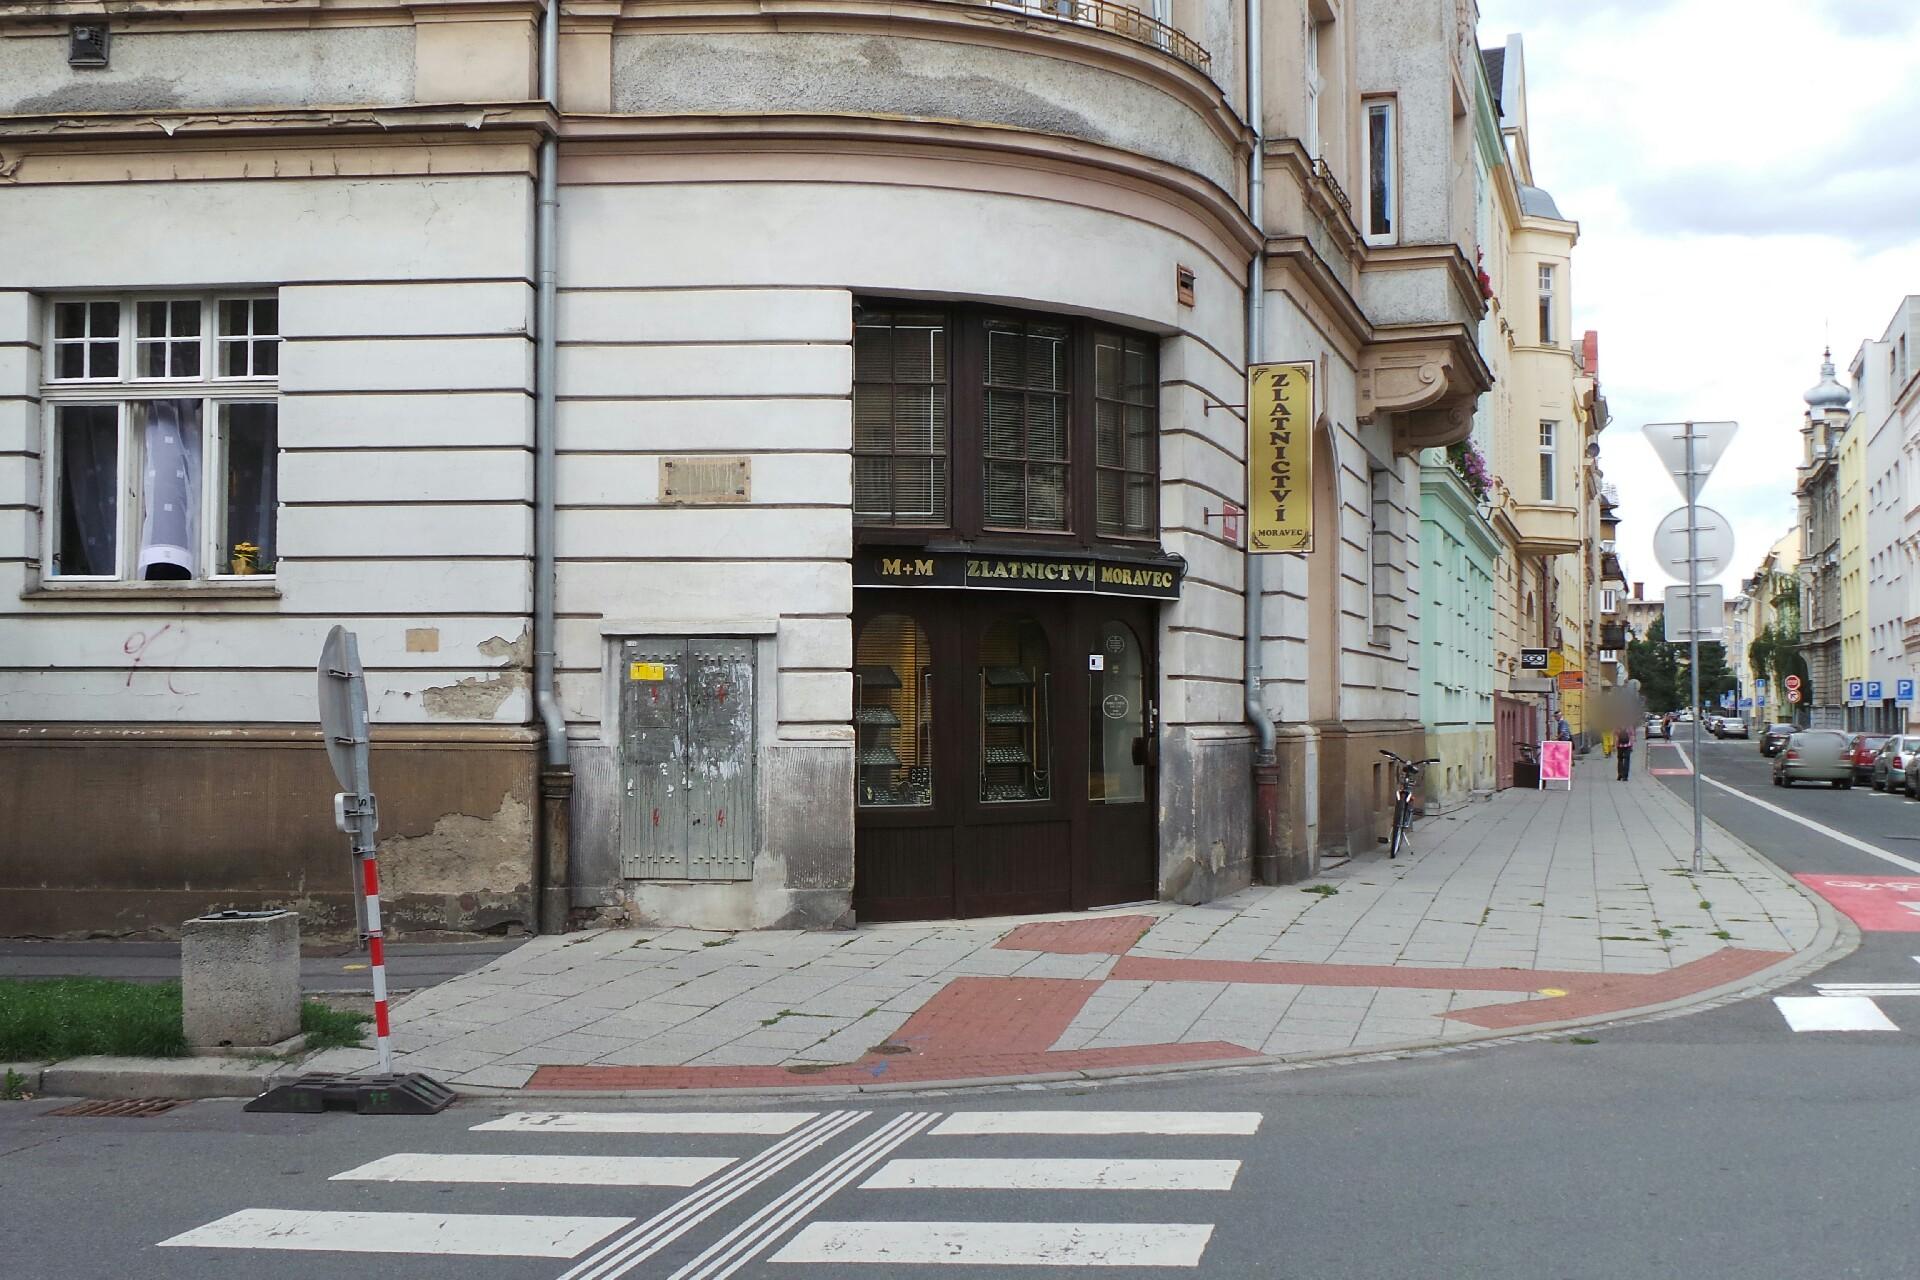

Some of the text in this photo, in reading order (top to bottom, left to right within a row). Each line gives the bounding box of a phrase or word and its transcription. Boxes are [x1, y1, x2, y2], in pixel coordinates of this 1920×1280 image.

[1269, 373, 1292, 522] ZLATNICTVÍ
[1258, 528, 1303, 537] MORAVEC
[882, 558, 934, 576] M+M
[1101, 566, 1172, 588] MORAVEC
[1851, 684, 1861, 696] P
[1868, 683, 1879, 696] P
[1900, 681, 1911, 695] P
